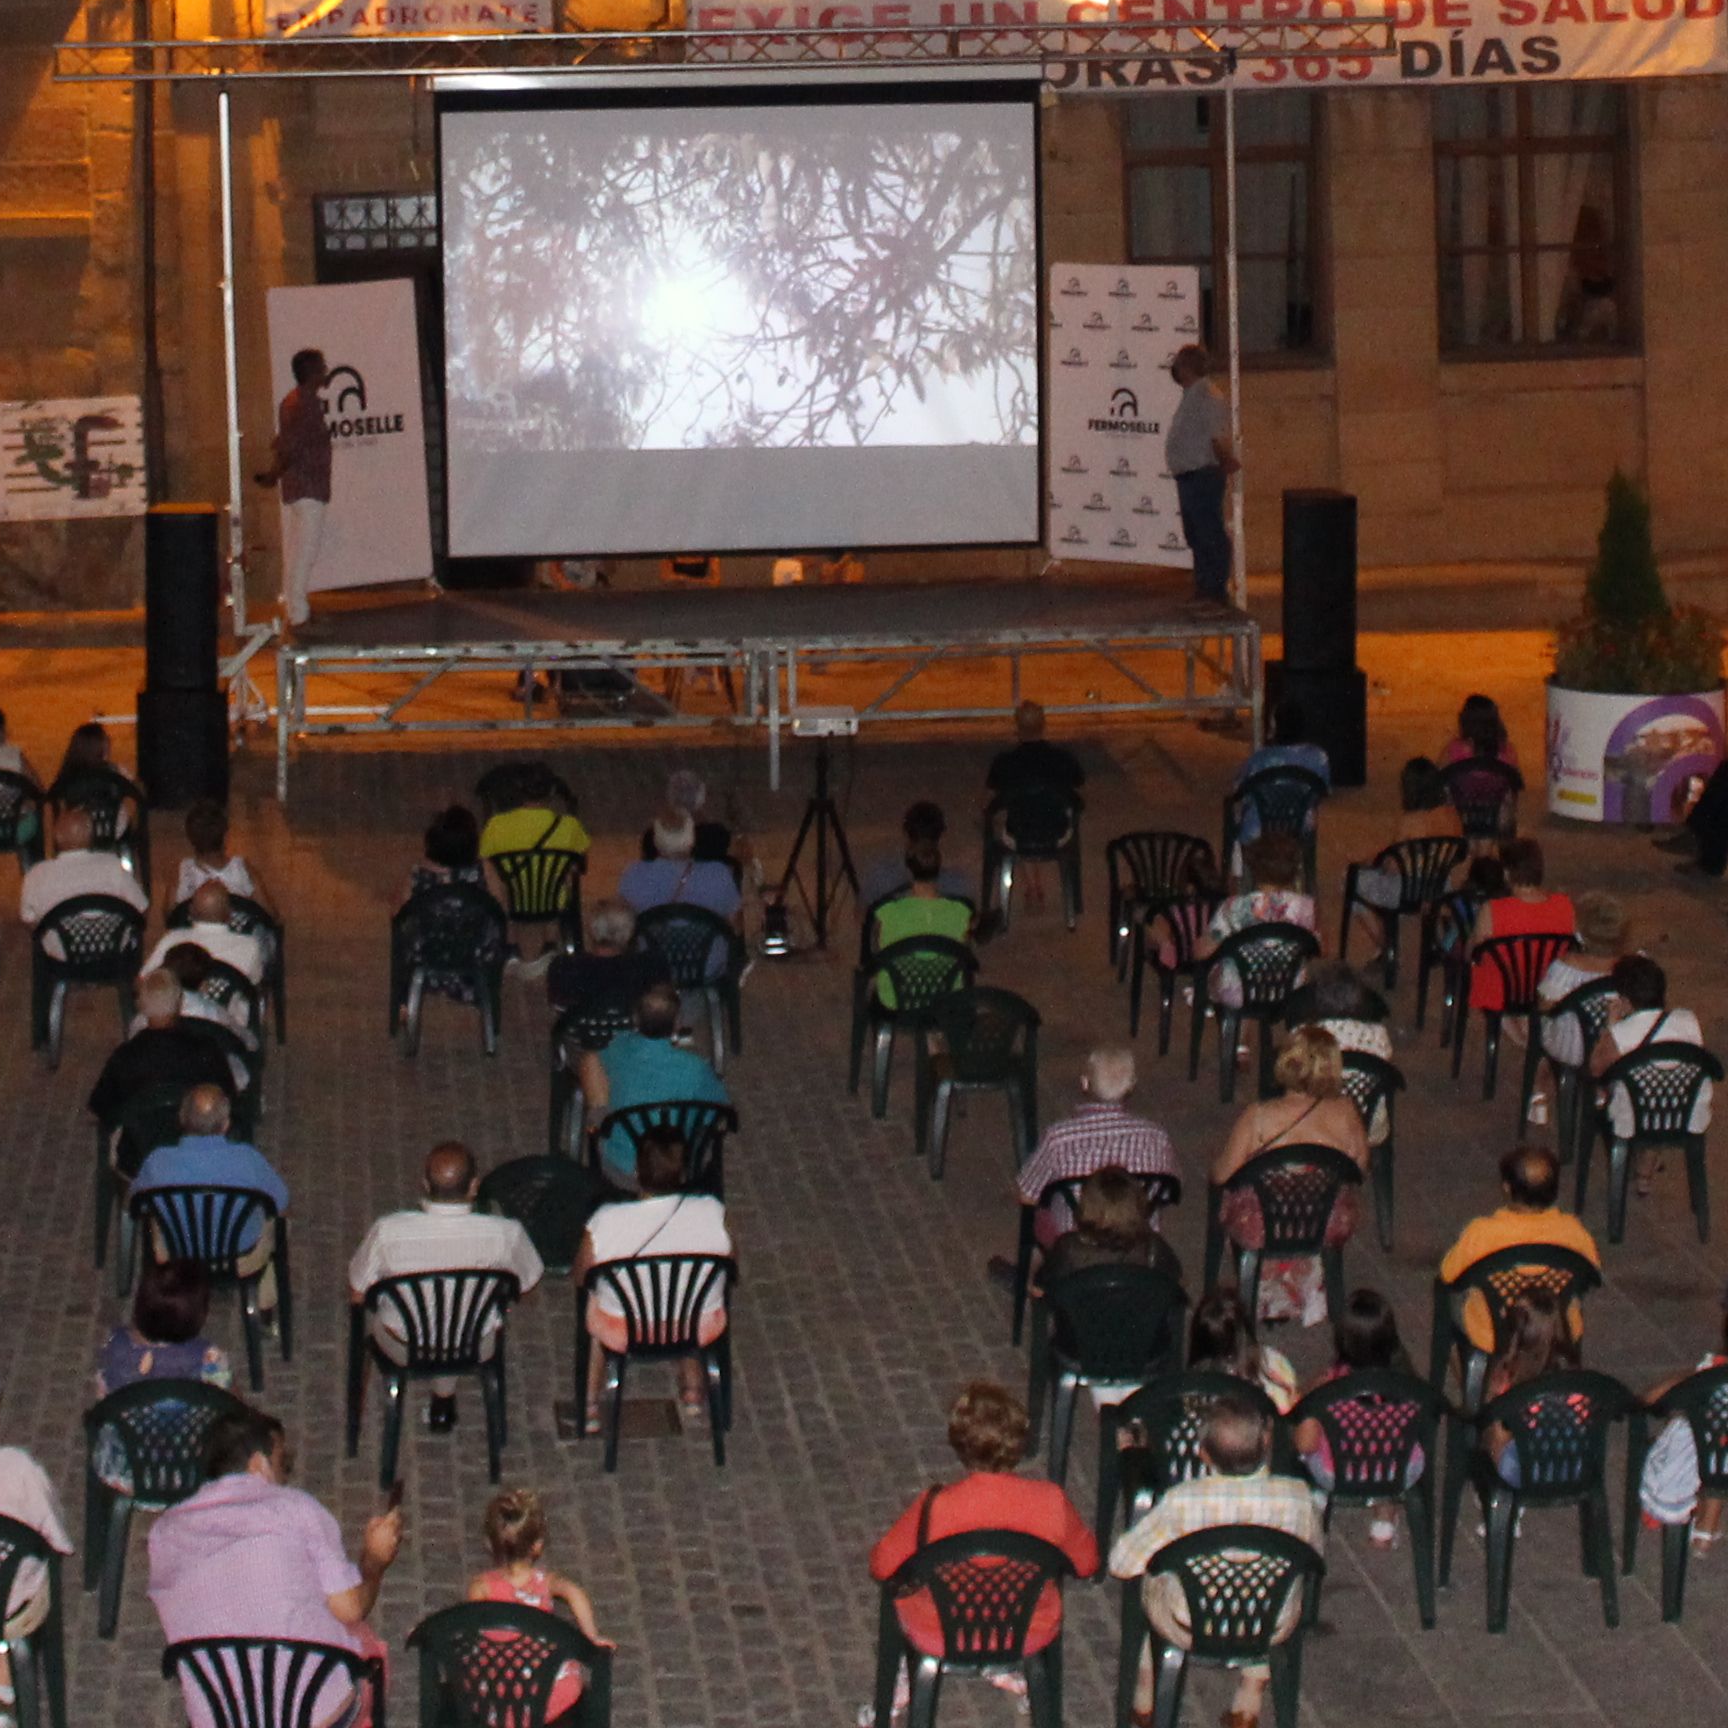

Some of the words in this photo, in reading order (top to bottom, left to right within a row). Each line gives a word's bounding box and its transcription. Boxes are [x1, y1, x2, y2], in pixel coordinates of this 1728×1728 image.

[695, 3, 913, 47] EXIGE
[939, 0, 1041, 43] UN
[1251, 44, 1374, 86] 365
[1398, 34, 1562, 80] DÍAS
[1087, 418, 1161, 435] FERMOSELLE
